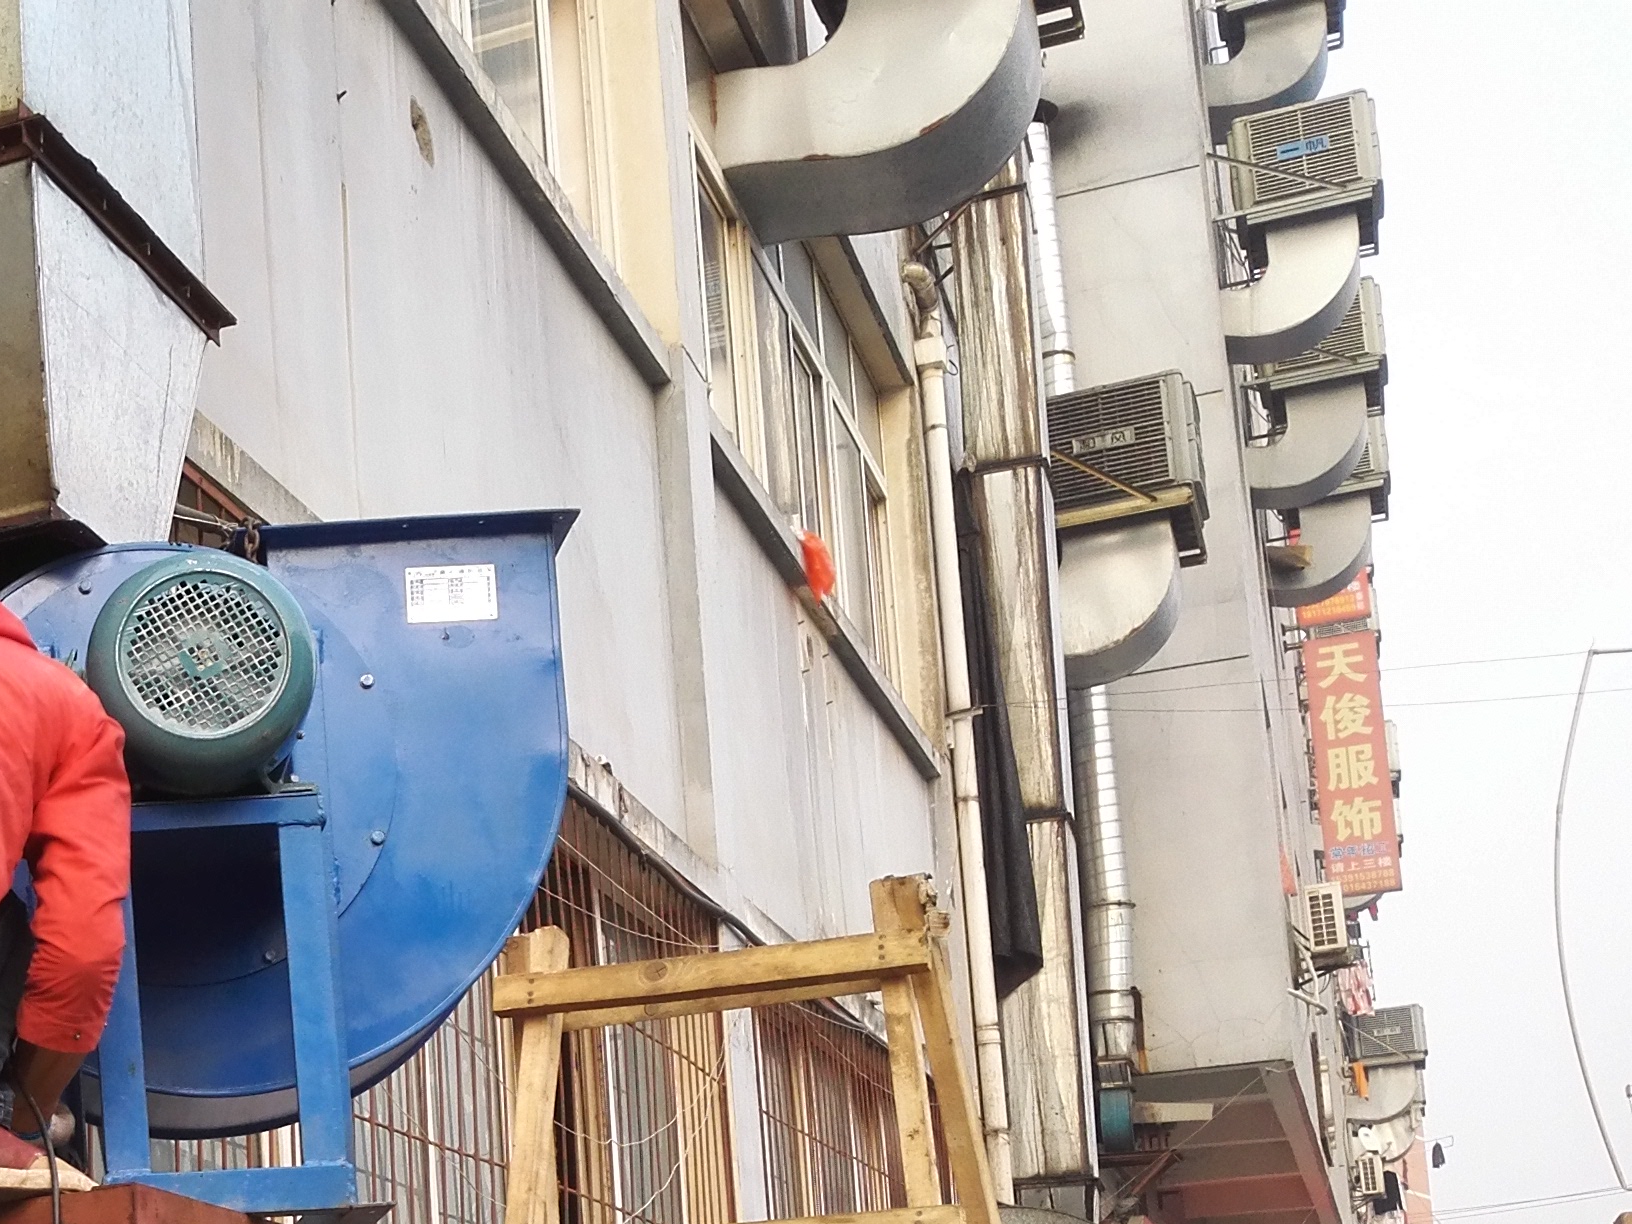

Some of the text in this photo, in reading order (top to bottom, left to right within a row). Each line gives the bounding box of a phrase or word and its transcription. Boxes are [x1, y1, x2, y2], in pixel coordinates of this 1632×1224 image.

[1316, 642, 1382, 842] 天俊服饰
[1330, 856, 1392, 873] 请上三楼
